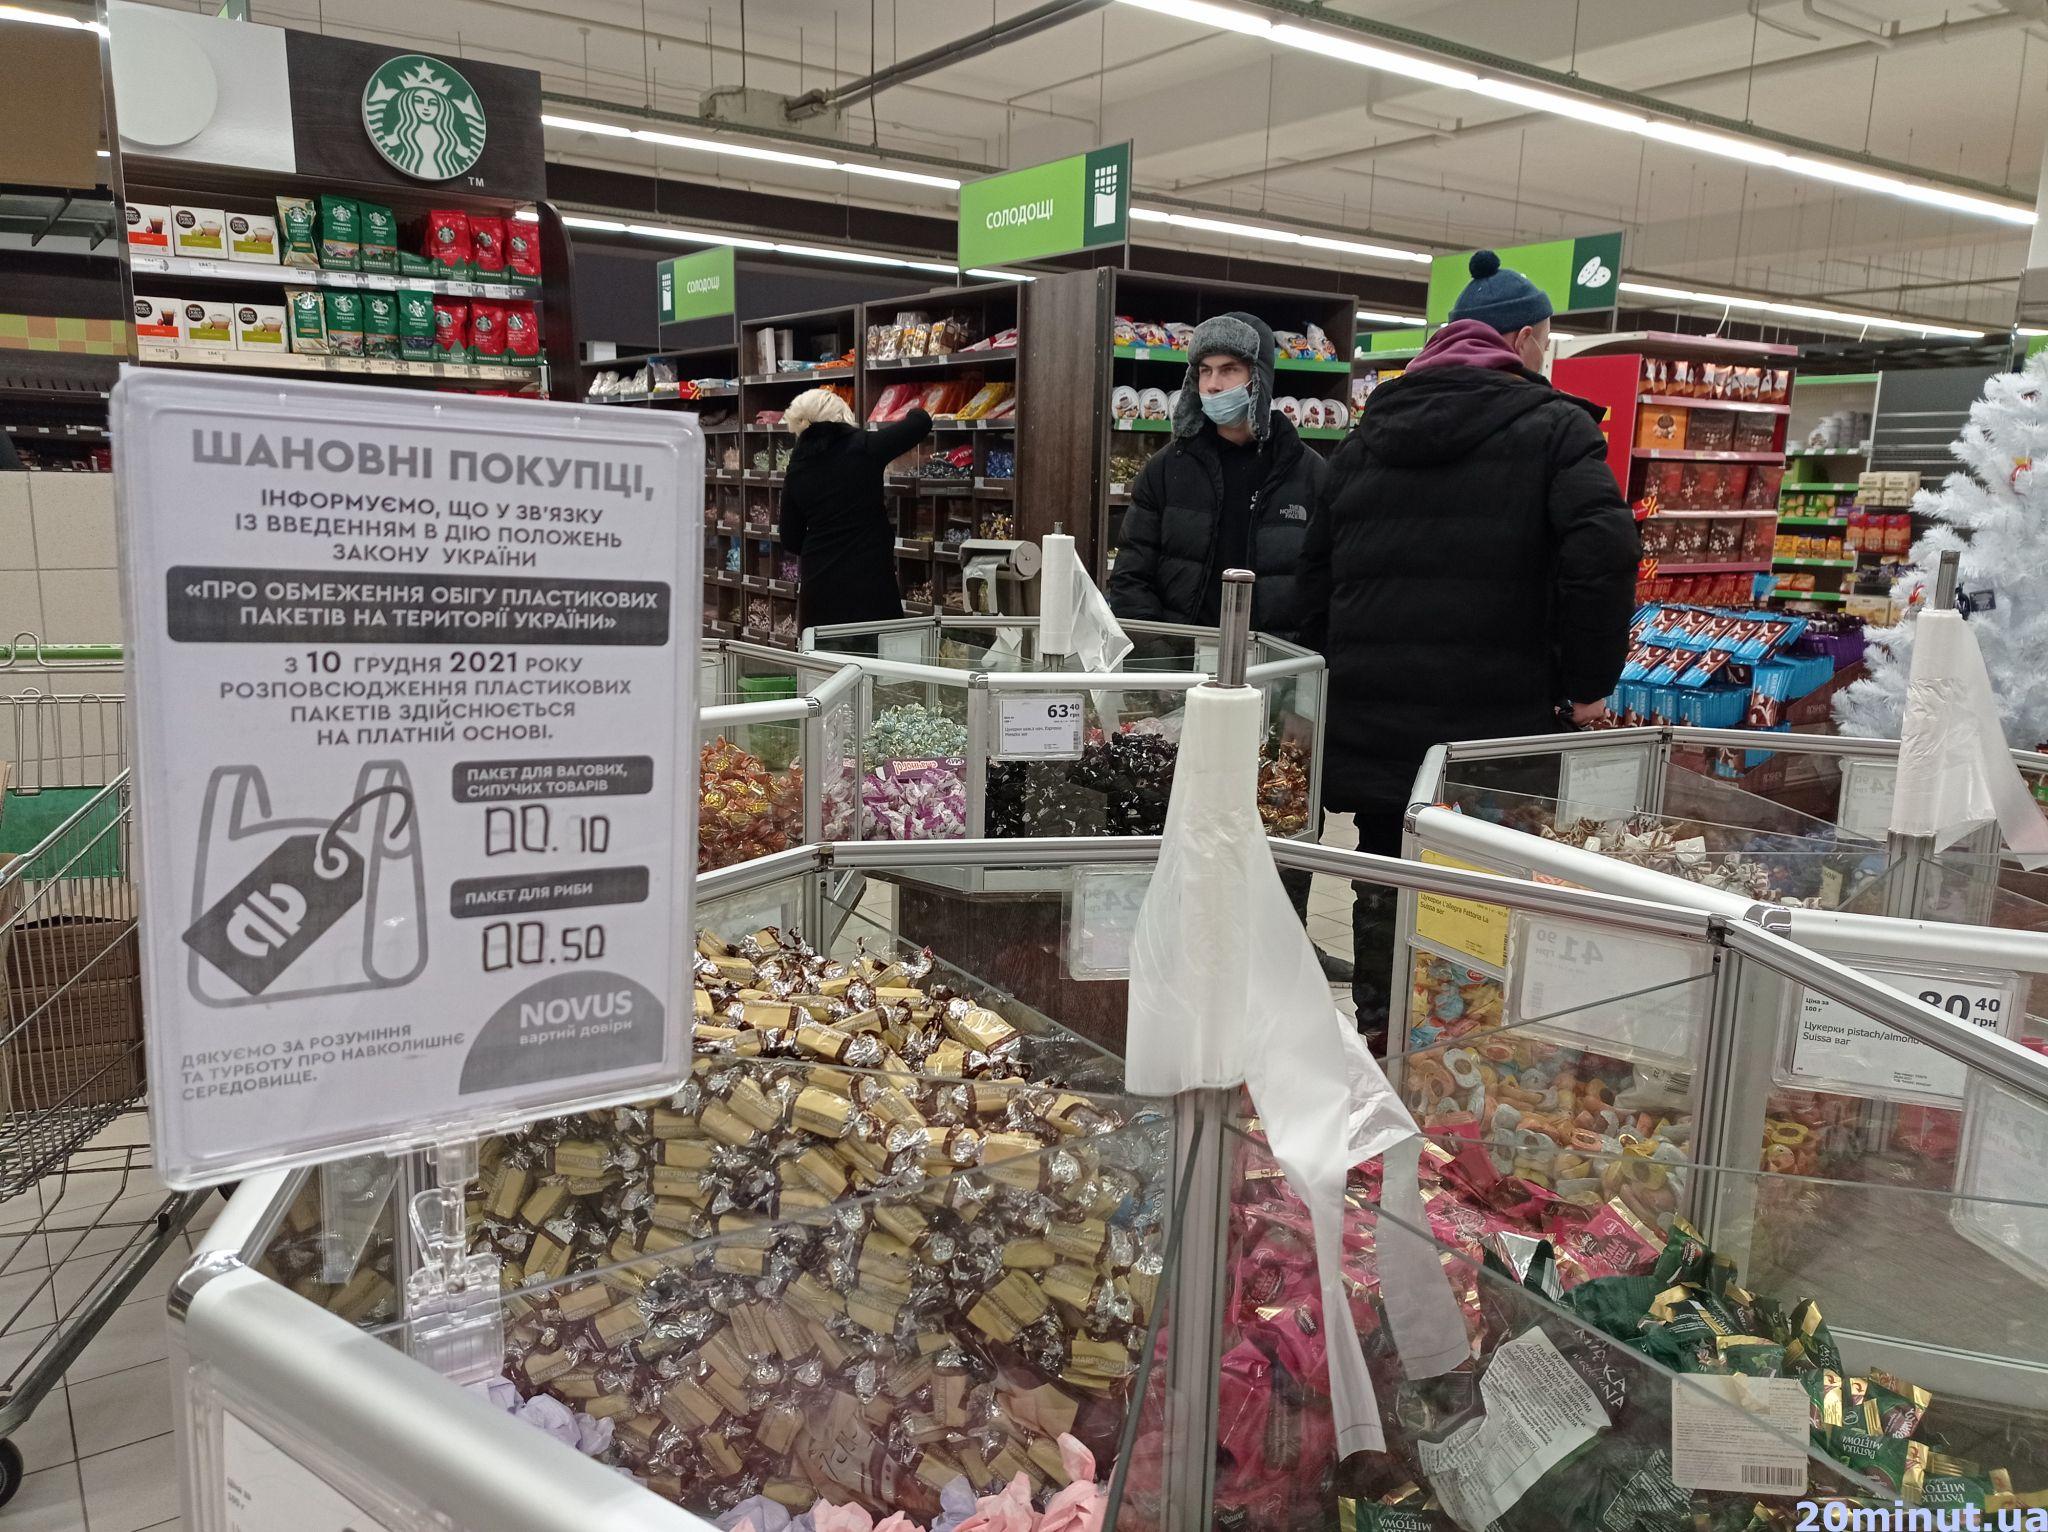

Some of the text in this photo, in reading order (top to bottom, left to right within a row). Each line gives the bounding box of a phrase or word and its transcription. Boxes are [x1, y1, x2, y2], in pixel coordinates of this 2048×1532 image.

[468, 177, 485, 187] TM
[985, 198, 1055, 231] СОЛОДОЩІ
[686, 274, 721, 294] СОЛОДОЩІ
[193, 429, 654, 500] ШАНОВНІ ПОКУПЦІ,
[261, 488, 604, 525] ІНФОРМУЄМО, ЩО У ЗВ'ЯЗКУ
[236, 514, 622, 548] ІЗ ВВЕДЕННЯМ В ДІЮ ПОЛОЖЕНЬ
[333, 544, 536, 566] ЗАКОНУ УКРАЇНИ
[186, 580, 658, 608] «ПРО ОБМЕЖЕННЯ ОБІГУ ПЛАСТИКОВИХ
[240, 607, 616, 629] ПАКЕТІВ НА ТЕРИТОРІЇ УКРАЇНИ»
[285, 650, 582, 675] З 10 ГРУДНЯ 2021 РОКУ
[220, 678, 631, 701] РОЗПОВСЮДЖЕННЯ ПЛАСТИКОВИХ
[291, 701, 575, 722] ПАКЕТІВ ЗДІЙСНЮЄТЬСЯ
[1047, 704, 1069, 718] 63
[317, 722, 553, 745] НА ПЛАТНІЙ ОСНОВІ.
[467, 762, 628, 782] ПАКЕТ ДЛЯ ВАГОВИХ,
[467, 778, 607, 797] СИПУЧИХ ТОВАРІВ
[465, 883, 593, 904] ПАКЕТ ДЛЯ РИБИ
[520, 991, 633, 1028] NOVUS
[1805, 998, 1821, 1006] Ціна
[1975, 998, 2001, 1012] 40
[520, 1020, 632, 1047] вартий довіри
[1804, 1021, 1845, 1034] Цукерки
[1973, 1018, 1997, 1028] грн
[182, 1025, 411, 1072] ДЯКУЄМО ЗА РОЗУМІННЯ
[1803, 1031, 1851, 1046] Suissa ваг
[182, 1031, 464, 1086] ТА ТУРБОТУ ПРО НАВКОЛИШНЄ
[182, 1074, 317, 1100] СЕРЕДОВИЩЕ.
[1843, 1443, 1876, 1460] PASTYLKA
